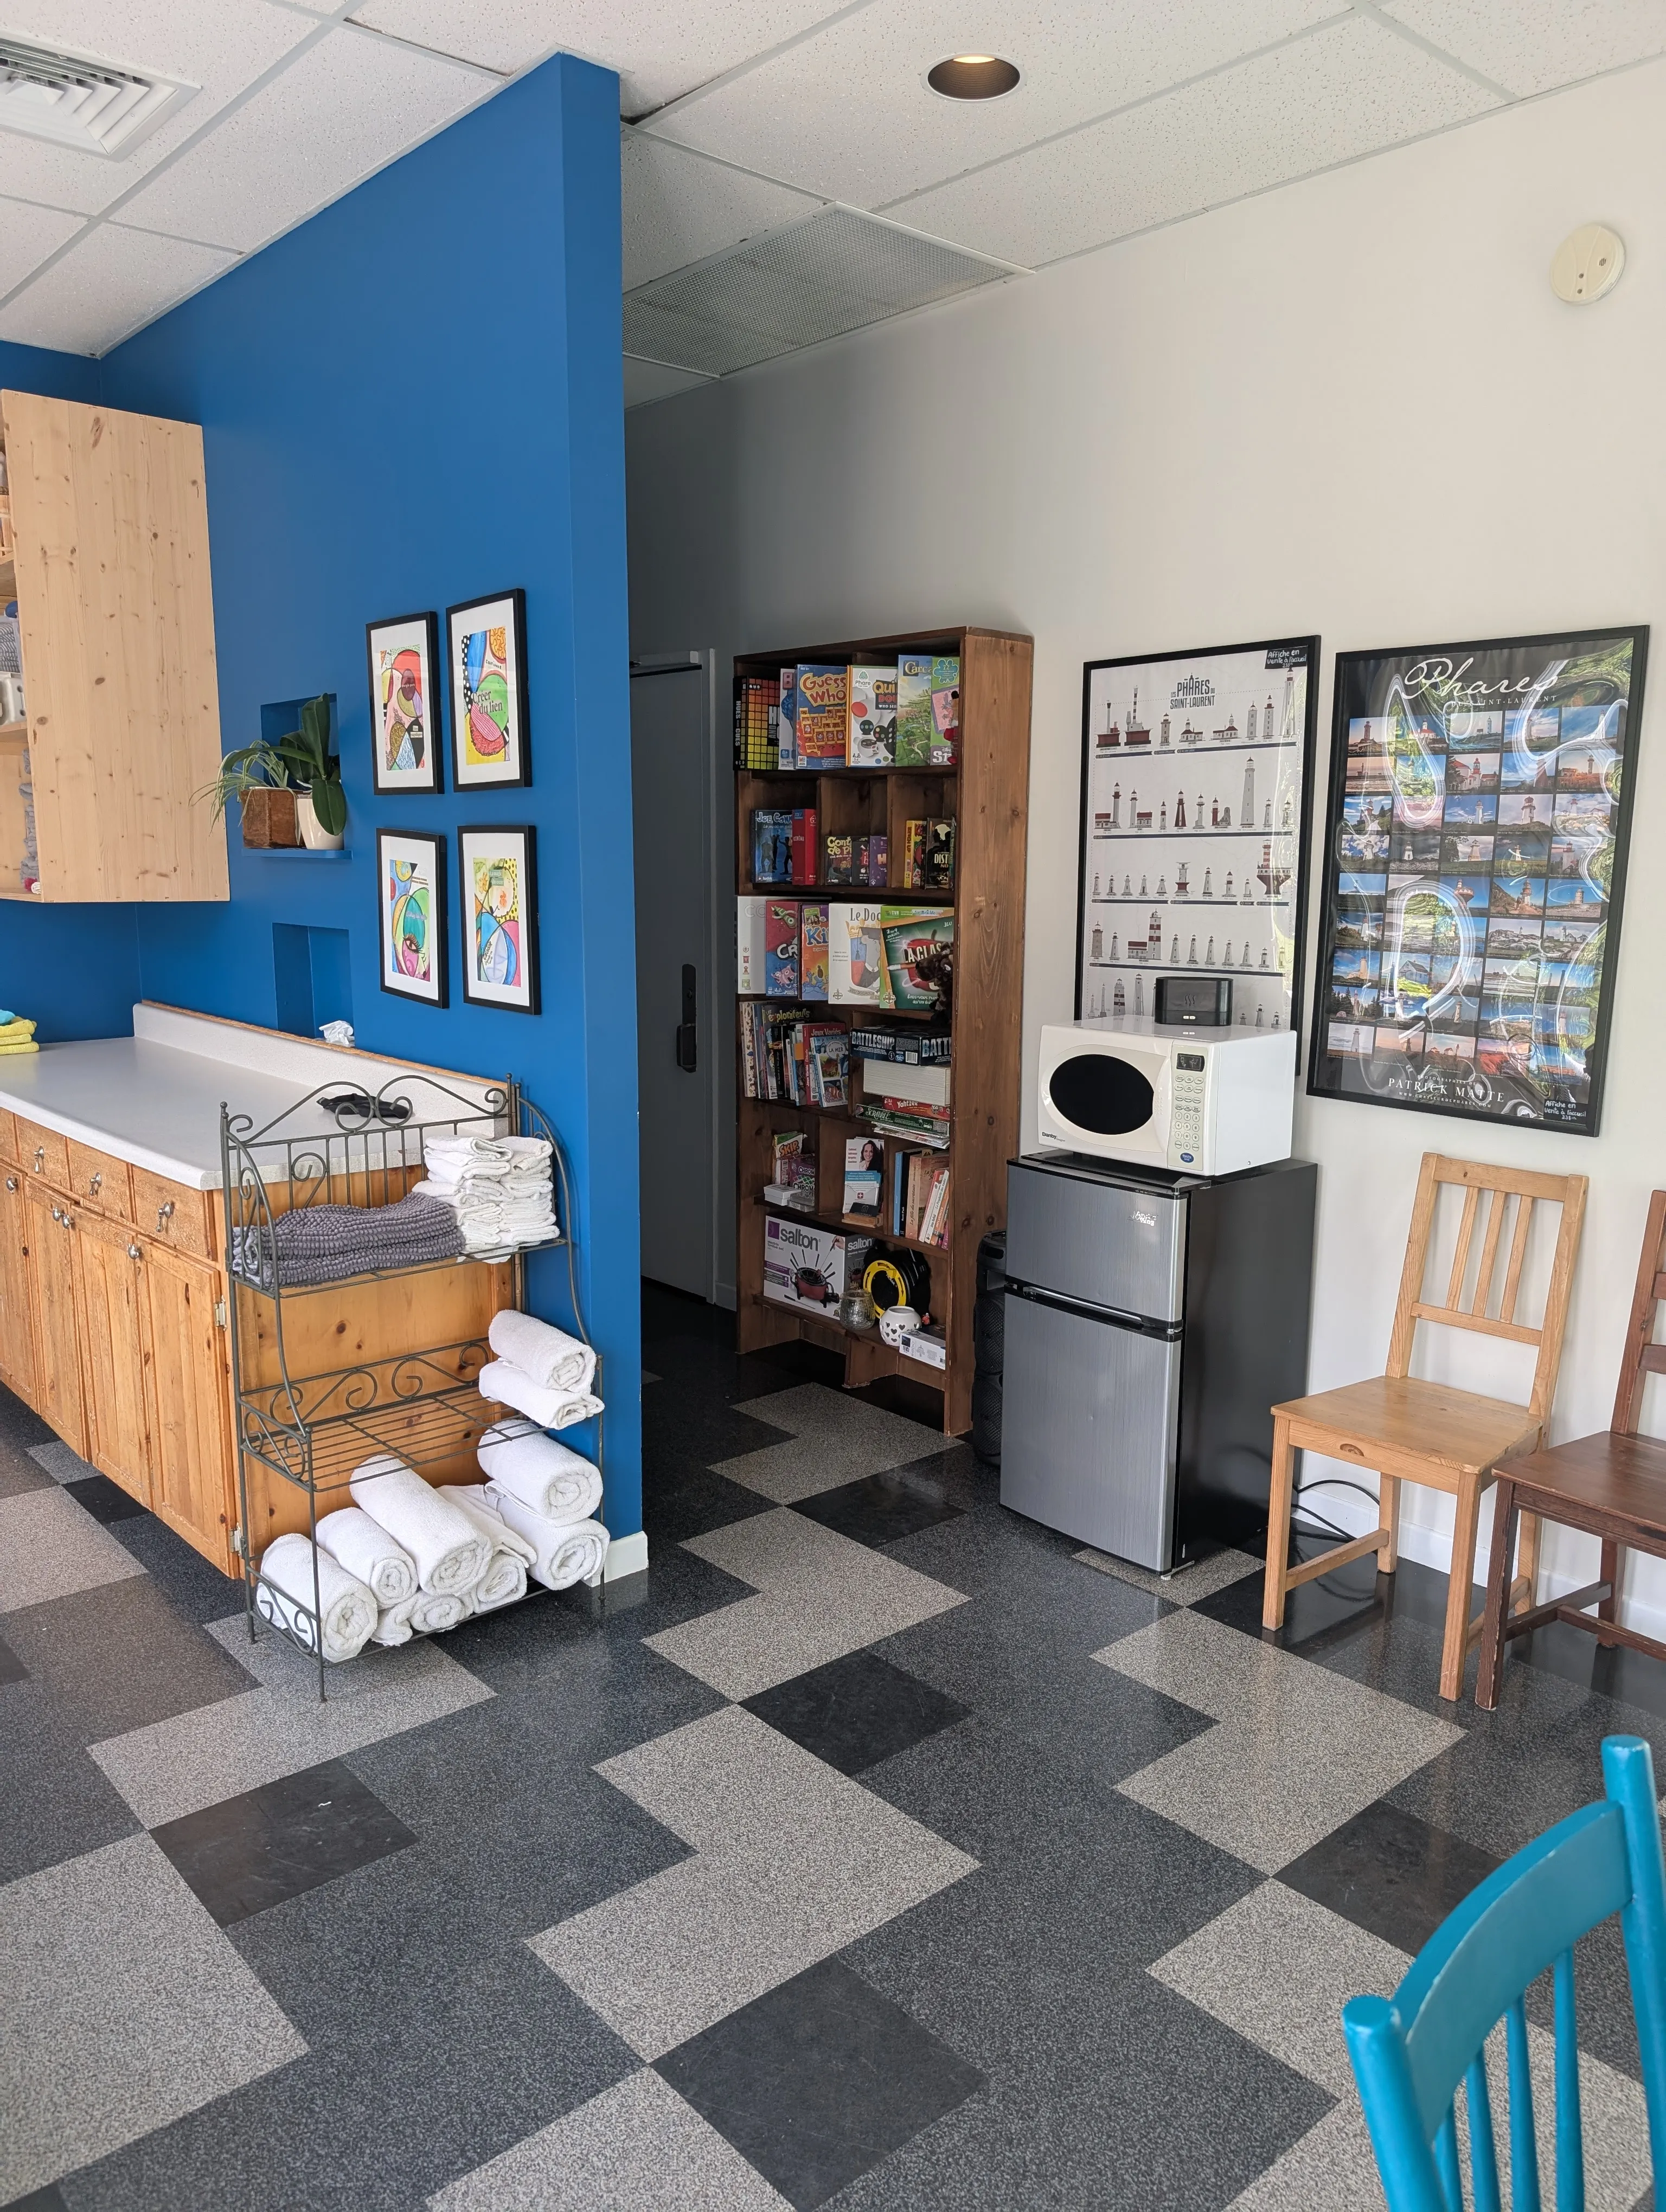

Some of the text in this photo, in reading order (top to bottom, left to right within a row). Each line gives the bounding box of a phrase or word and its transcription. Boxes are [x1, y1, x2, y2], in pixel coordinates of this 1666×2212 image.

[1268, 650, 1290, 658] Affiche
[1401, 657, 1558, 699] Phares
[1177, 677, 1210, 697] PHARES
[473, 690, 491, 704] Créer
[1170, 695, 1215, 710] SAINT-LAURENT
[1470, 695, 1558, 706] SAINT-LAURENT
[479, 700, 503, 714] du lien
[850, 908, 861, 921] Le
[824, 1028, 841, 1036] Variés
[851, 1031, 895, 1050] BATTLESHIP
[1388, 1077, 1505, 1102] PATRICK MATTE
[896, 1100, 918, 1109] Yahtzee
[865, 1107, 891, 1120] SCRABBLE
[1042, 1131, 1056, 1140] Danby
[780, 1228, 818, 1251] salton
[847, 1238, 872, 1251] salton
